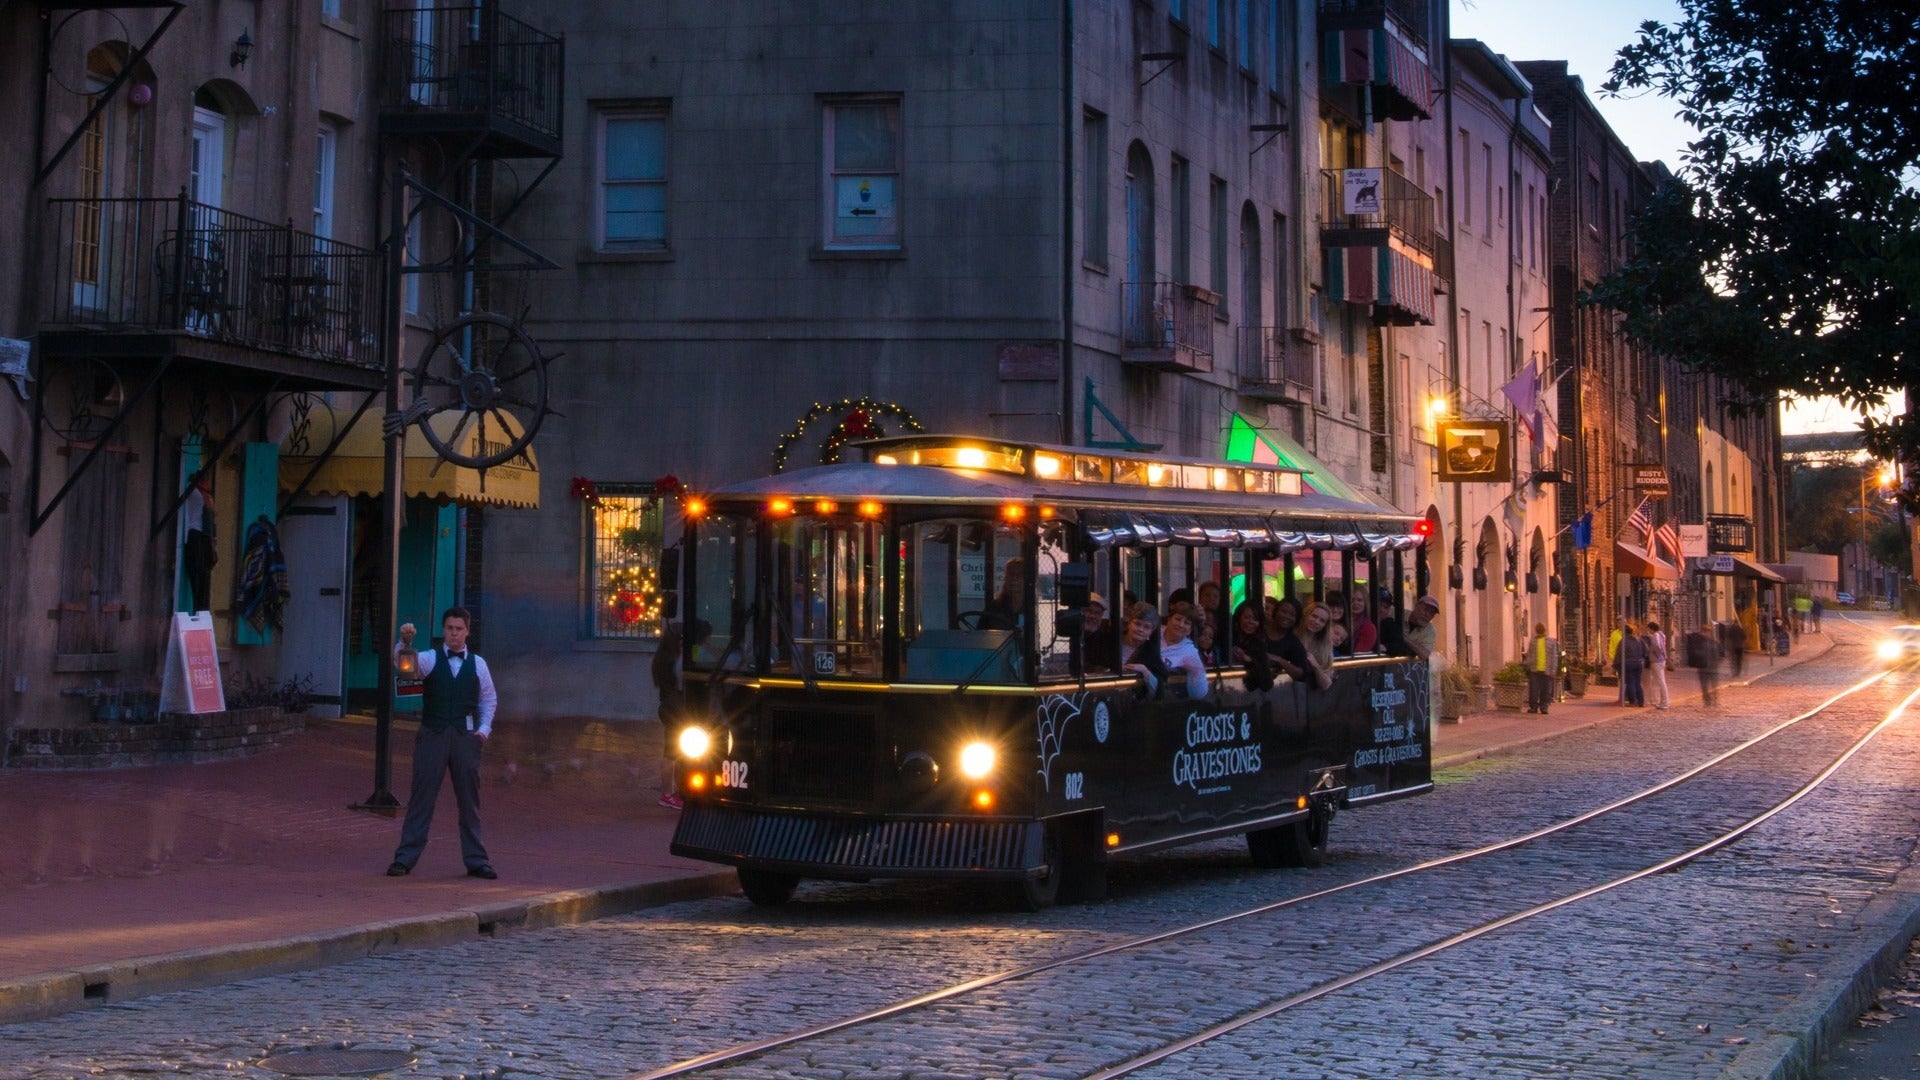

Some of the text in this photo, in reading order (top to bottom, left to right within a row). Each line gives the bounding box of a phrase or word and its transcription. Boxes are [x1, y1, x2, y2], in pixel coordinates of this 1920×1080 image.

[1355, 178, 1369, 186] Bay
[816, 655, 833, 670] 126
[1384, 672, 1395, 690] FOR
[1371, 687, 1406, 712] RESERVATIONS
[1187, 711, 1251, 747] GHOSTS &
[1383, 709, 1396, 724] CALL
[1173, 743, 1261, 790] GRAVESTONES
[1354, 743, 1423, 769] GHOSTS & GRAVESTONES
[722, 760, 749, 789] 802
[1065, 772, 1083, 800] 802
